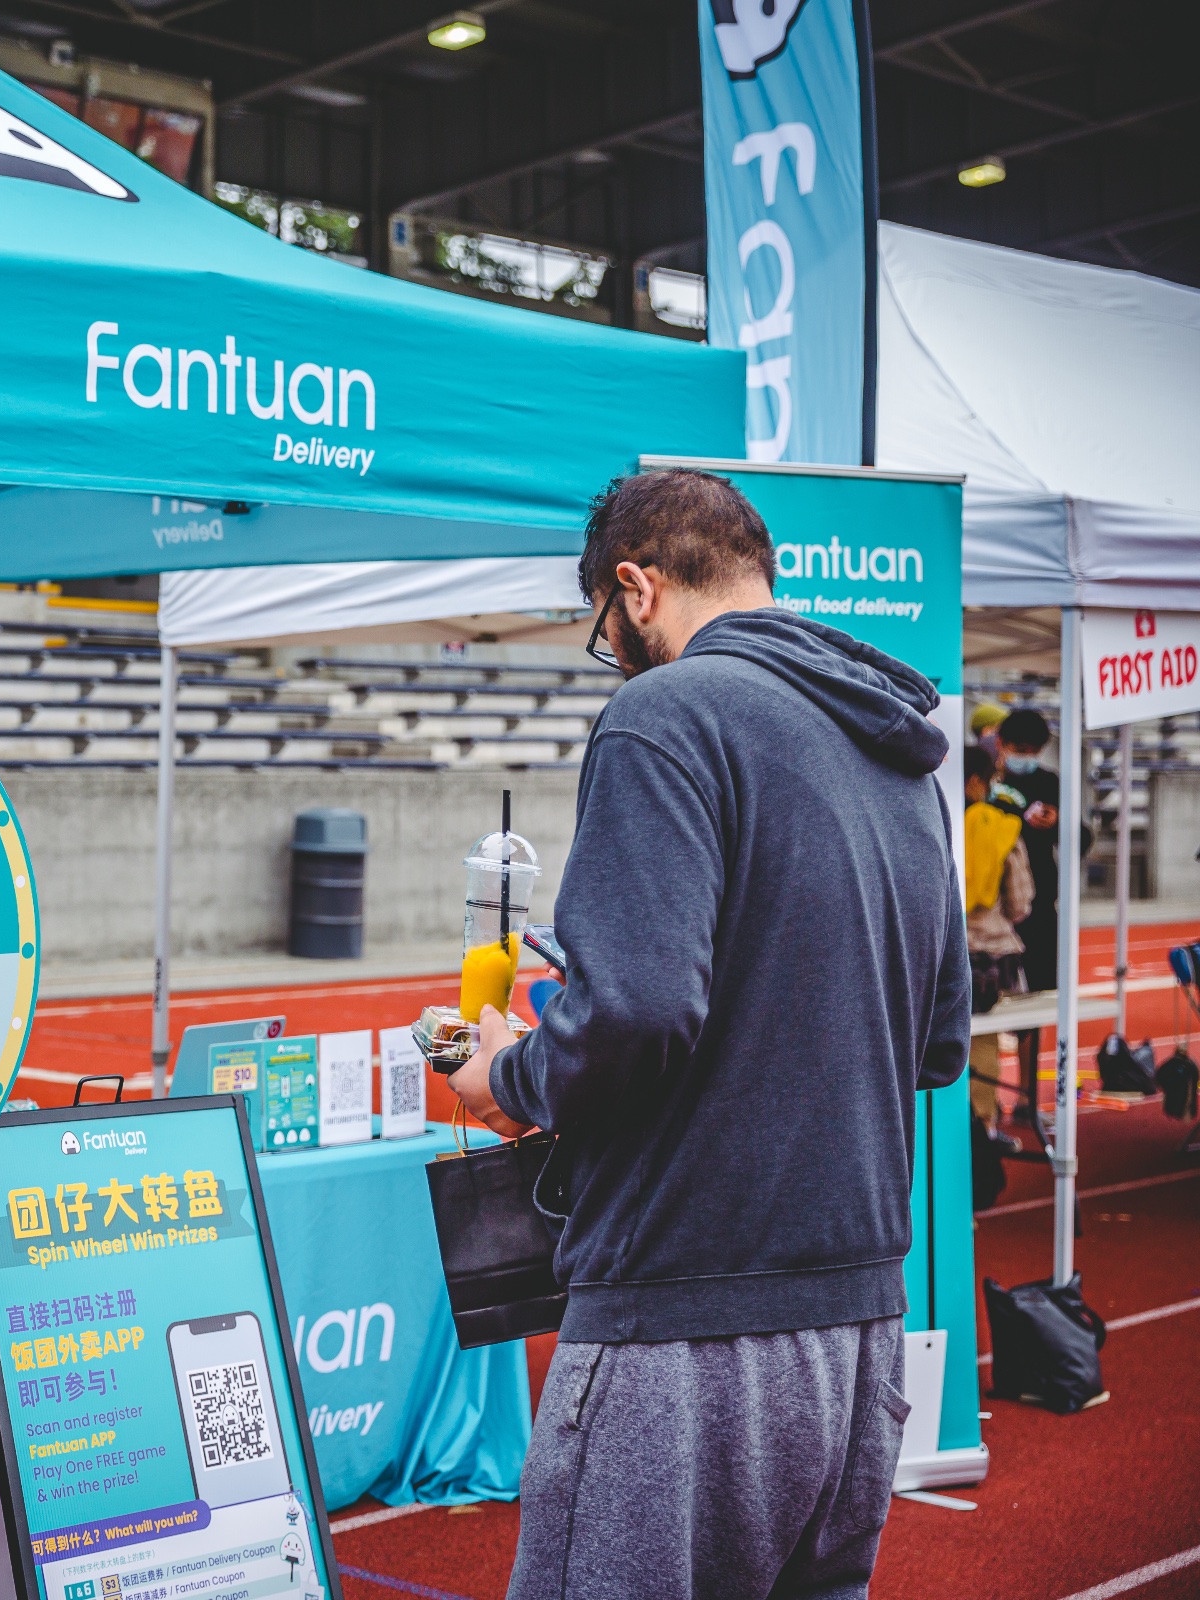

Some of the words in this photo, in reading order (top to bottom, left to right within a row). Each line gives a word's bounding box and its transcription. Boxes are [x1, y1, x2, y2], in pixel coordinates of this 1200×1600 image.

[85, 320, 376, 430] Fantuan
[273, 433, 375, 476] Delivery
[770, 535, 924, 583] antuan
[814, 594, 853, 615] food
[853, 596, 924, 623] delivery
[1098, 649, 1154, 698] FIRST
[1160, 645, 1198, 688] AID
[83, 1129, 147, 1151] Fantuan
[124, 1146, 148, 1156] Delivery
[8, 1170, 223, 1240] 团仔大转盘
[27, 1243, 69, 1269] Spin
[72, 1234, 128, 1259] Wheel
[132, 1228, 166, 1250] Win
[168, 1223, 219, 1246] Prizes
[6, 1289, 137, 1334] 直接扫码注册
[11, 1326, 145, 1371] 饭团外卖APP
[26, 1418, 62, 1438] Scan
[64, 1412, 90, 1432] and
[93, 1404, 144, 1430] register
[29, 1437, 88, 1460] Fantuan
[91, 1430, 117, 1449] APP
[33, 1462, 63, 1482] Play
[66, 1456, 94, 1475] One
[96, 1452, 126, 1469] FREE
[128, 1445, 167, 1467] game
[37, 1488, 48, 1503] &
[50, 1483, 75, 1501] win
[78, 1478, 100, 1495] the
[103, 1470, 140, 1494] prize!
[105, 1524, 134, 1540] What
[135, 1519, 153, 1533] will
[154, 1517, 174, 1533] you
[175, 1509, 199, 1526] win?
[172, 1559, 207, 1576] Fantuan
[209, 1552, 242, 1568] Delivery
[243, 1544, 276, 1560] Coupon
[105, 1579, 116, 1590] $3
[175, 1579, 211, 1595] Fantuan
[212, 1570, 246, 1586] Coupon
